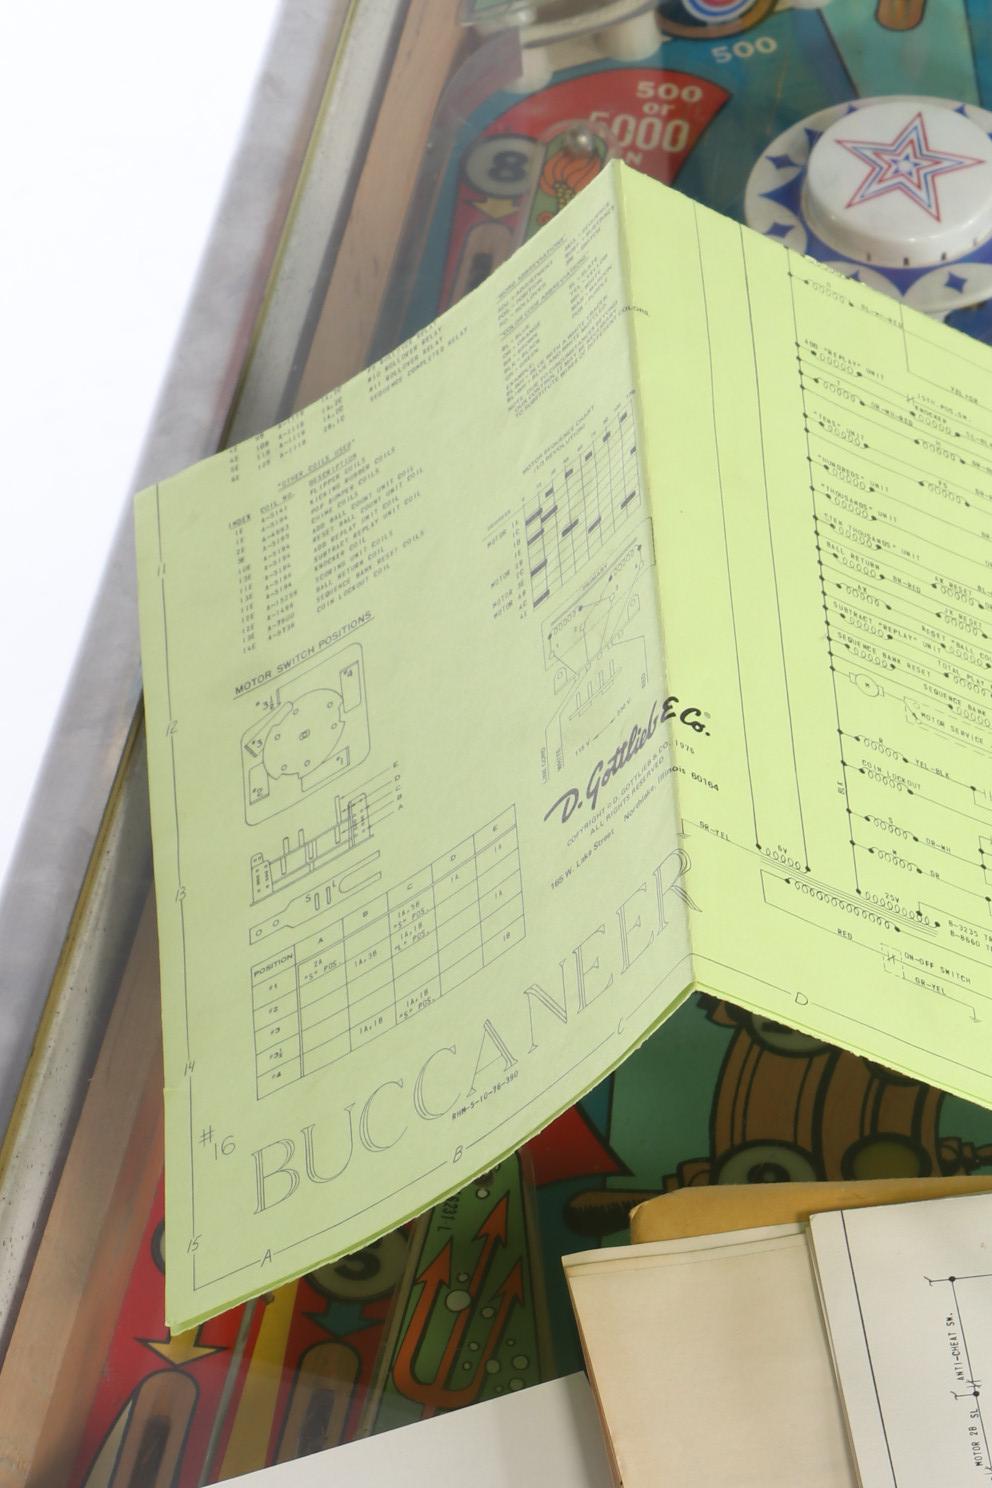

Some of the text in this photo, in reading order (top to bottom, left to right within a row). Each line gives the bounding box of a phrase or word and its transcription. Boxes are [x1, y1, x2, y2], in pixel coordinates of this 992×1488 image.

[711, 36, 778, 64] 500
[636, 81, 704, 103] 500
[642, 102, 675, 116] or
[234, 610, 373, 695] MOTOR SWITCH POSITIONS
[680, 707, 711, 737] Co.
[921, 711, 946, 727] MOTOR
[950, 724, 984, 745] SERVICE
[690, 770, 720, 792] 60164
[861, 758, 922, 791] COIN LOCKOUT
[576, 849, 593, 869] Lake
[592, 828, 616, 851] Street
[253, 950, 295, 979] POSITION
[904, 951, 972, 985] ON-OFF SWITCH
[250, 847, 703, 1216] BUCCANEER
[949, 1332, 965, 1382] ANTI-CHEAT
[970, 1440, 984, 1467] MOTOR
